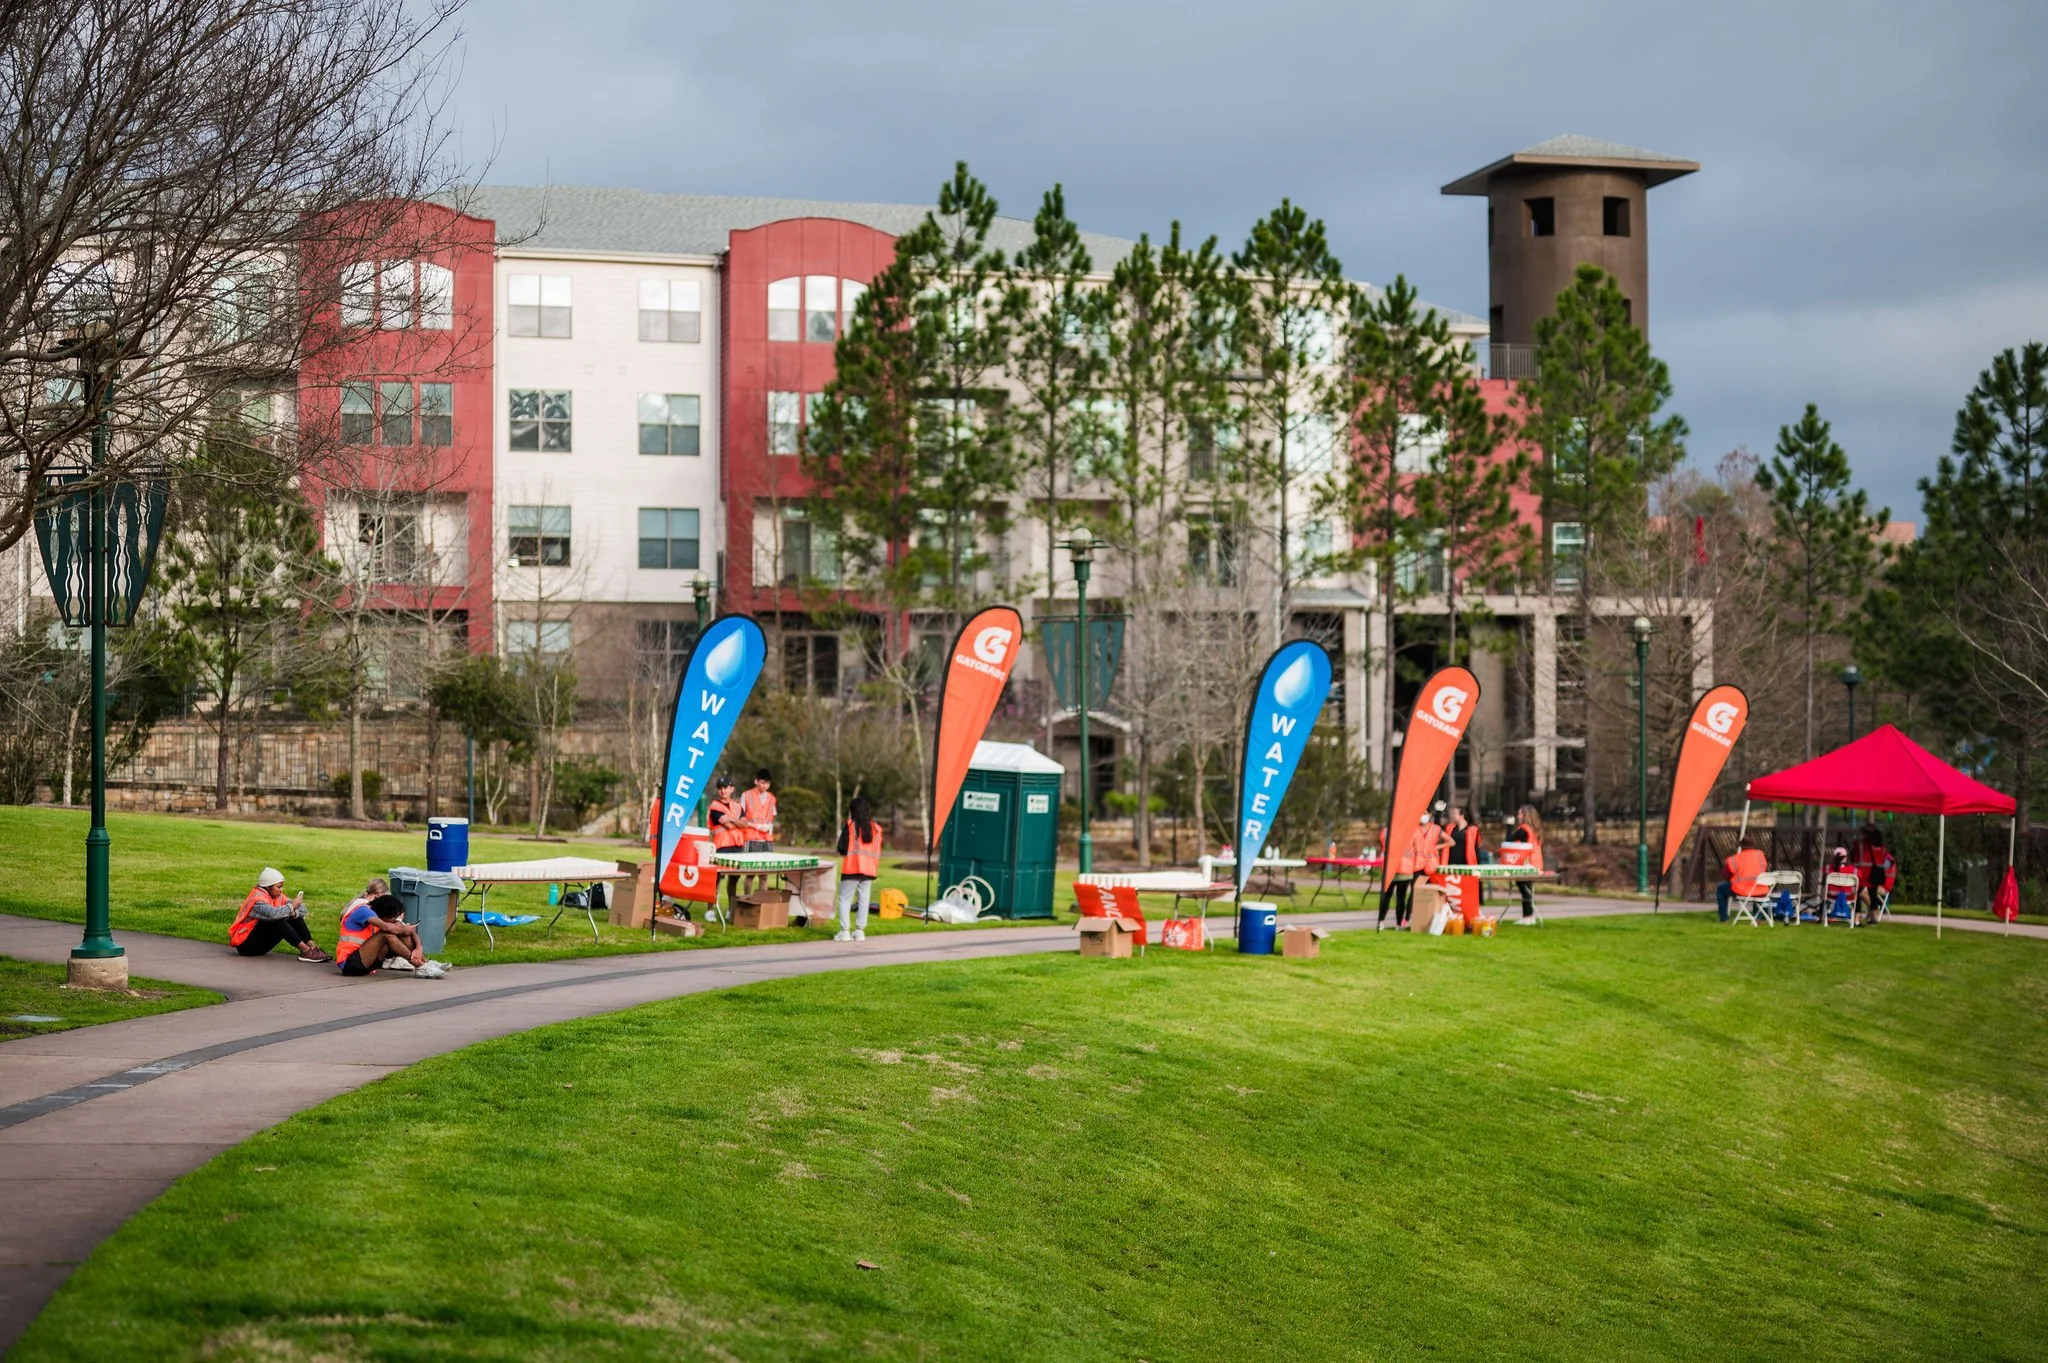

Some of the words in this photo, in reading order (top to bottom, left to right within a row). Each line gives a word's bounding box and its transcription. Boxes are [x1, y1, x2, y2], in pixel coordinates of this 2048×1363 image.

[973, 626, 1013, 664] G
[1432, 685, 1469, 722] G
[1706, 702, 1739, 734] G
[1416, 709, 1461, 738] GATORADE
[666, 689, 726, 828] WATER
[1244, 712, 1296, 841] WATER
